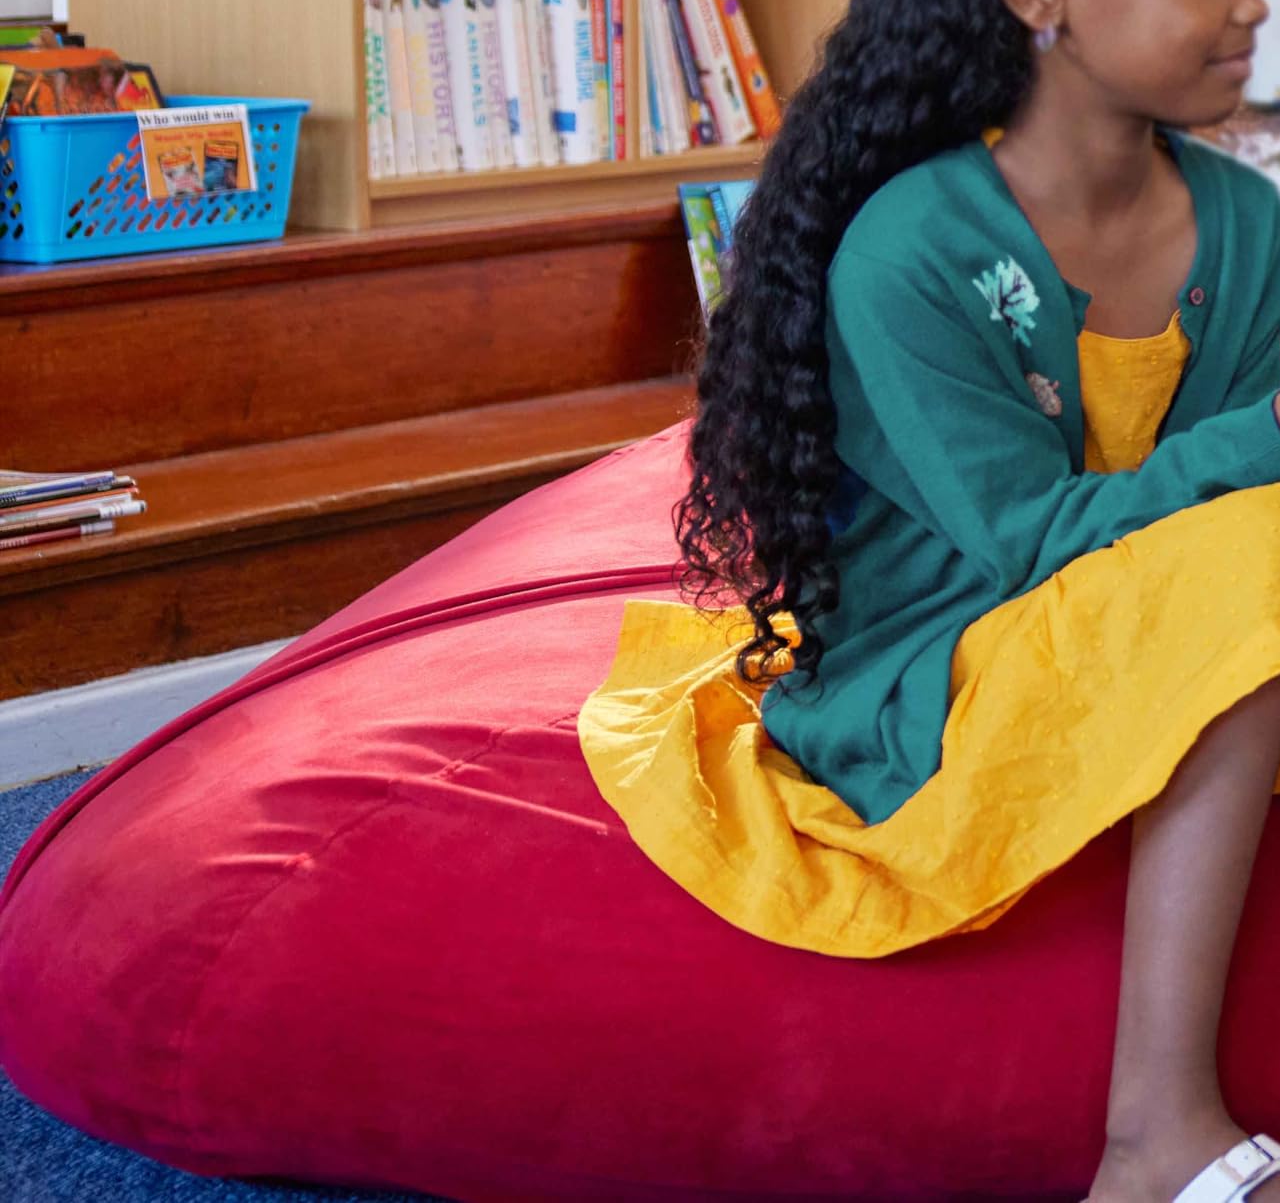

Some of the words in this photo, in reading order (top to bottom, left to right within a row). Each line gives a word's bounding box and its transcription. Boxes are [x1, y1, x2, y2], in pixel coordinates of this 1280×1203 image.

[140, 113, 169, 126] Who
[173, 110, 209, 123] would
[426, 20, 453, 136] HISTORY
[466, 21, 487, 128] ANIMALS
